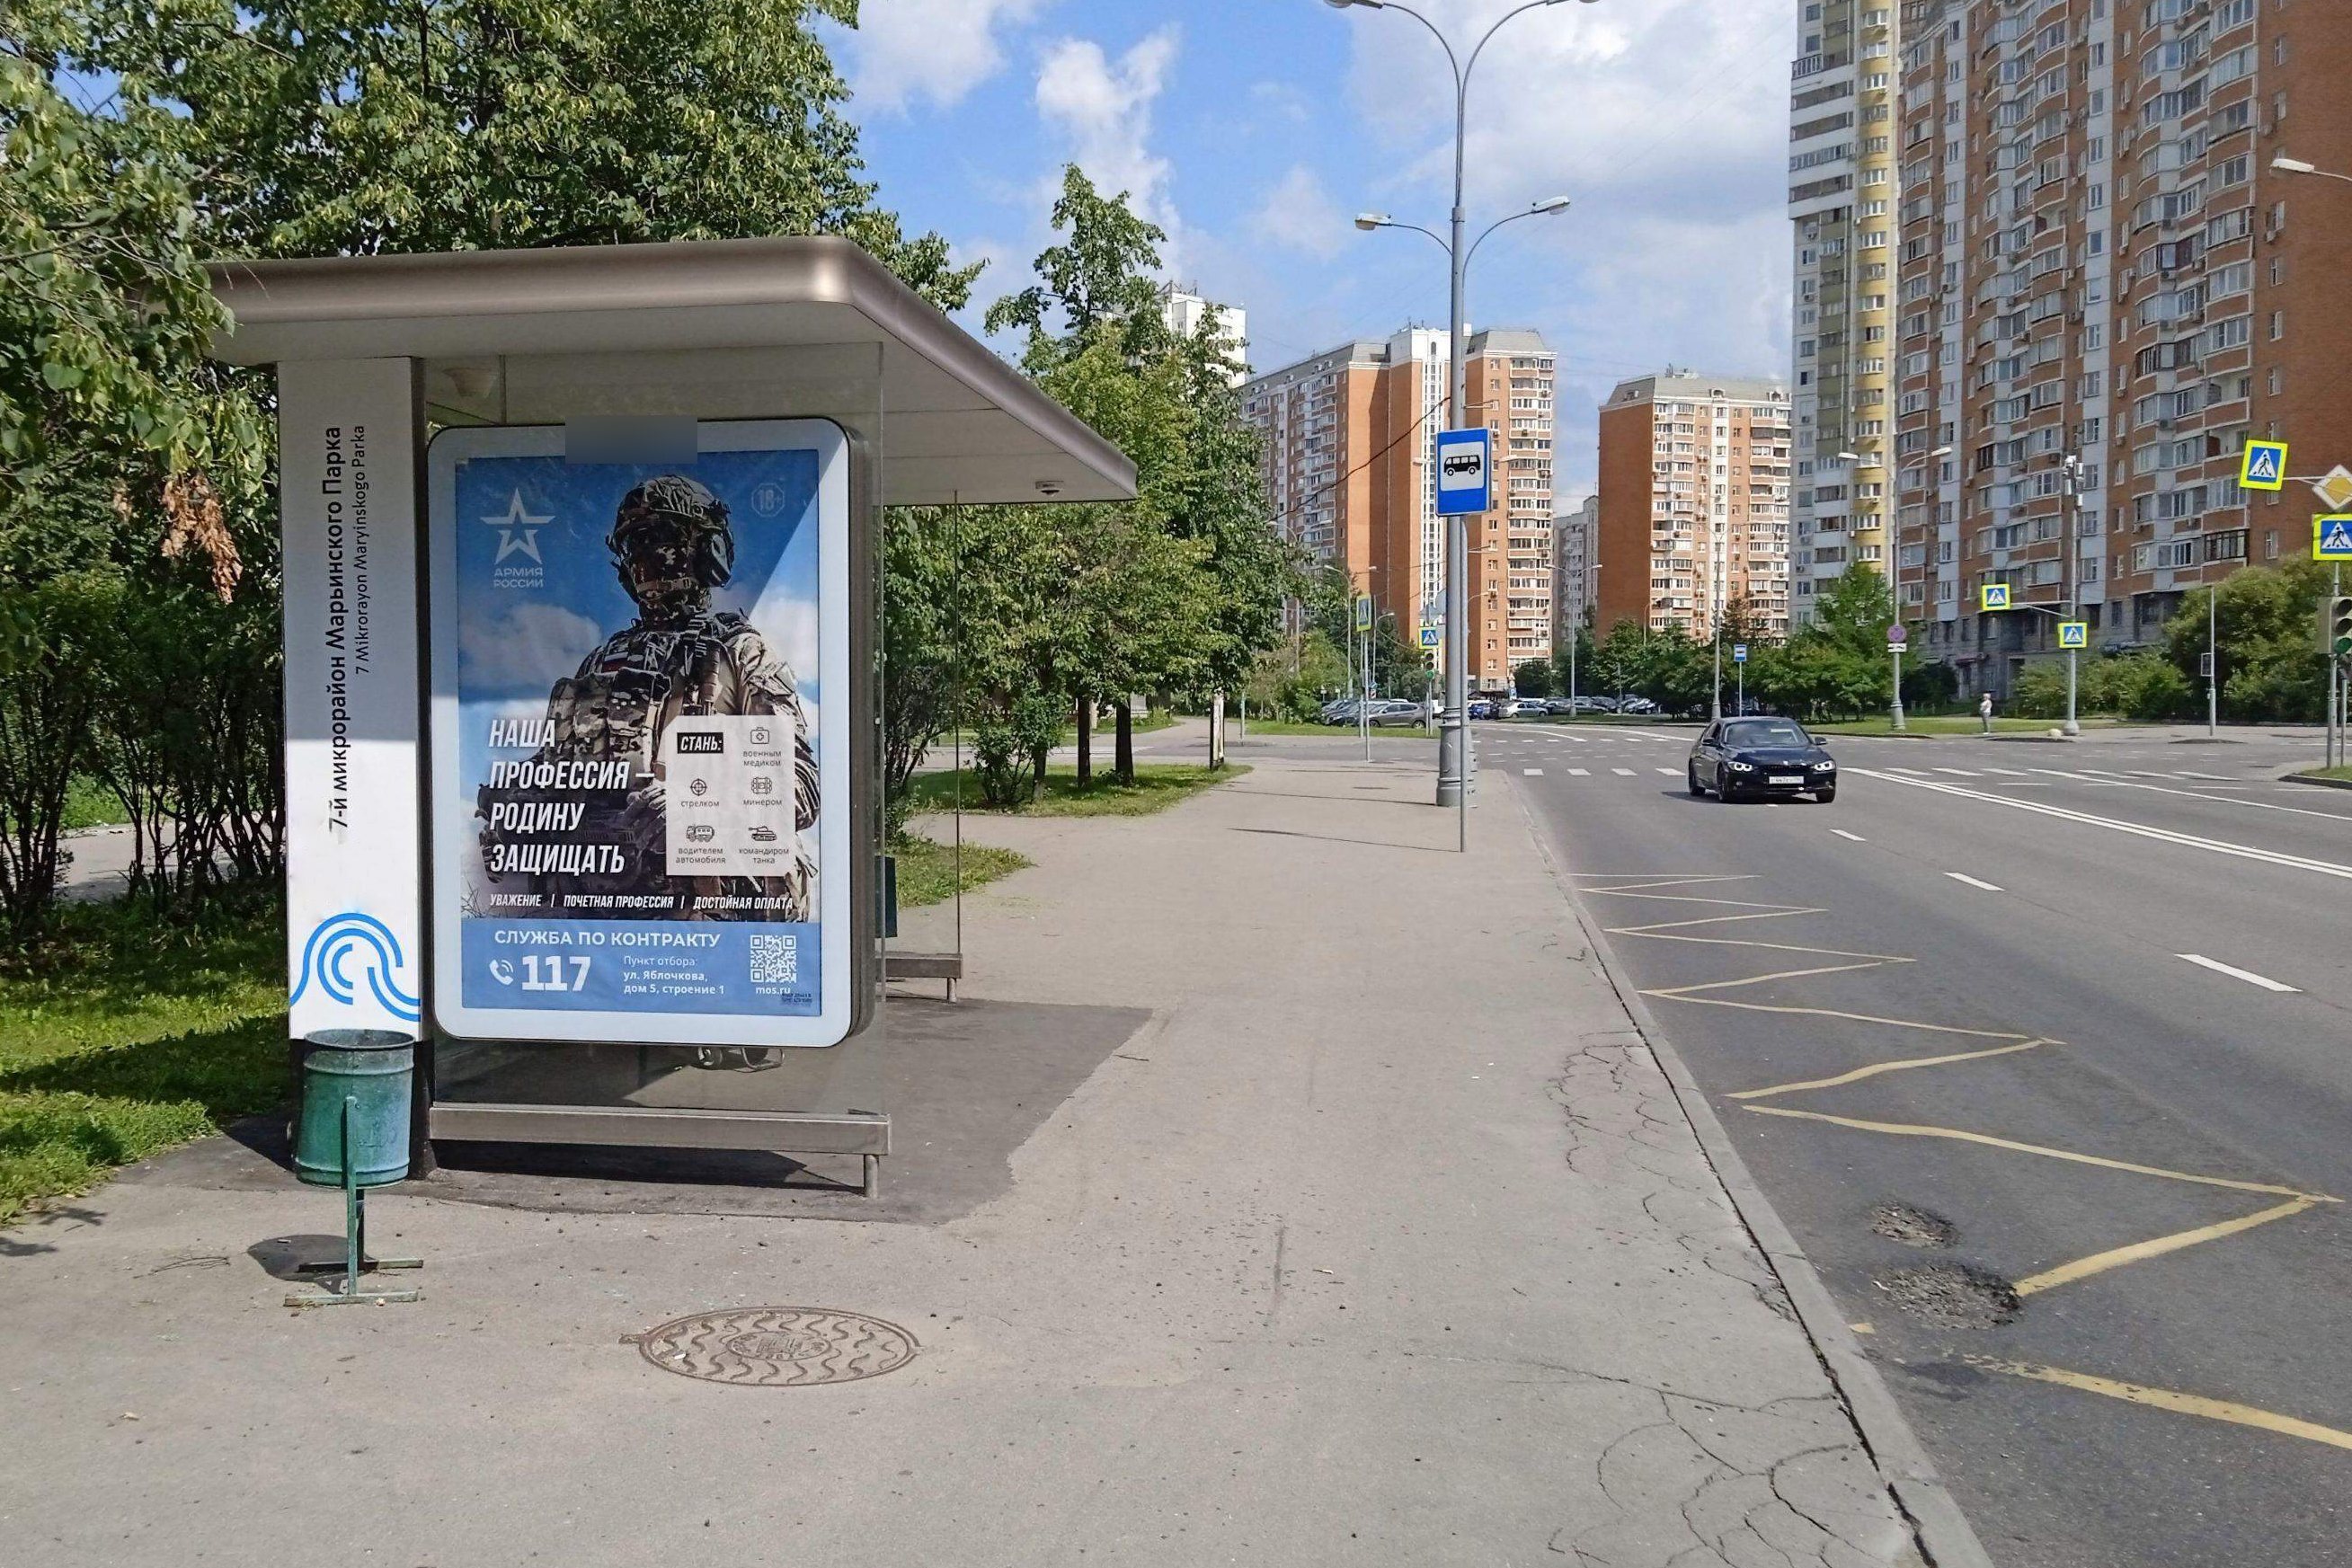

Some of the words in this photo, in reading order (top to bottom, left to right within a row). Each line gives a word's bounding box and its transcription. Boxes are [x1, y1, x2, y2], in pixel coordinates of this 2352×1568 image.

[350, 425, 366, 467] Parka
[322, 427, 346, 495] Парка
[351, 471, 370, 571] Maryinskogo
[324, 501, 349, 651] Марьинского
[494, 567, 544, 577] АРМИЯ
[493, 579, 544, 589] РОССИИ
[354, 574, 371, 662] Mikrorayon
[355, 666, 369, 675] 7
[325, 656, 351, 792] микрорайон
[488, 719, 556, 749] НАША
[679, 735, 723, 752] СТАНЬ:
[743, 759, 782, 767] медиком
[489, 761, 630, 790] ПРОФЕССИЯ
[680, 800, 720, 808] стрелком
[742, 799, 783, 807] минером
[324, 799, 349, 833] 7-й
[489, 802, 586, 834] РОДИНУ
[678, 846, 723, 855] водителем
[739, 847, 790, 855] командиром
[490, 843, 626, 877] ЗАЩИЩАТЬ
[675, 855, 726, 864] автомобиля
[752, 856, 776, 864] танка
[490, 893, 543, 908] УВАЖЕНИЕ
[563, 895, 613, 908] ПОЧЕТНАЯ
[614, 895, 674, 909] ПРОФЕССИЯ
[692, 894, 752, 909] ДОСТОЙНАЯ
[753, 896, 794, 910] ОПЛАТА
[494, 930, 572, 945] СЛУЖБА
[578, 931, 606, 945] ПО
[610, 932, 721, 948] КОНТРАКТУ
[624, 955, 656, 968] Пункт
[657, 956, 698, 968] отбора:
[521, 955, 591, 992] 117
[623, 971, 641, 981] ул.
[643, 970, 708, 983] Яблочкова,
[624, 985, 647, 995] дом
[649, 984, 660, 995] 5,
[662, 986, 716, 997] строение
[718, 985, 724, 995] 1
[755, 985, 791, 995] mos.ru
